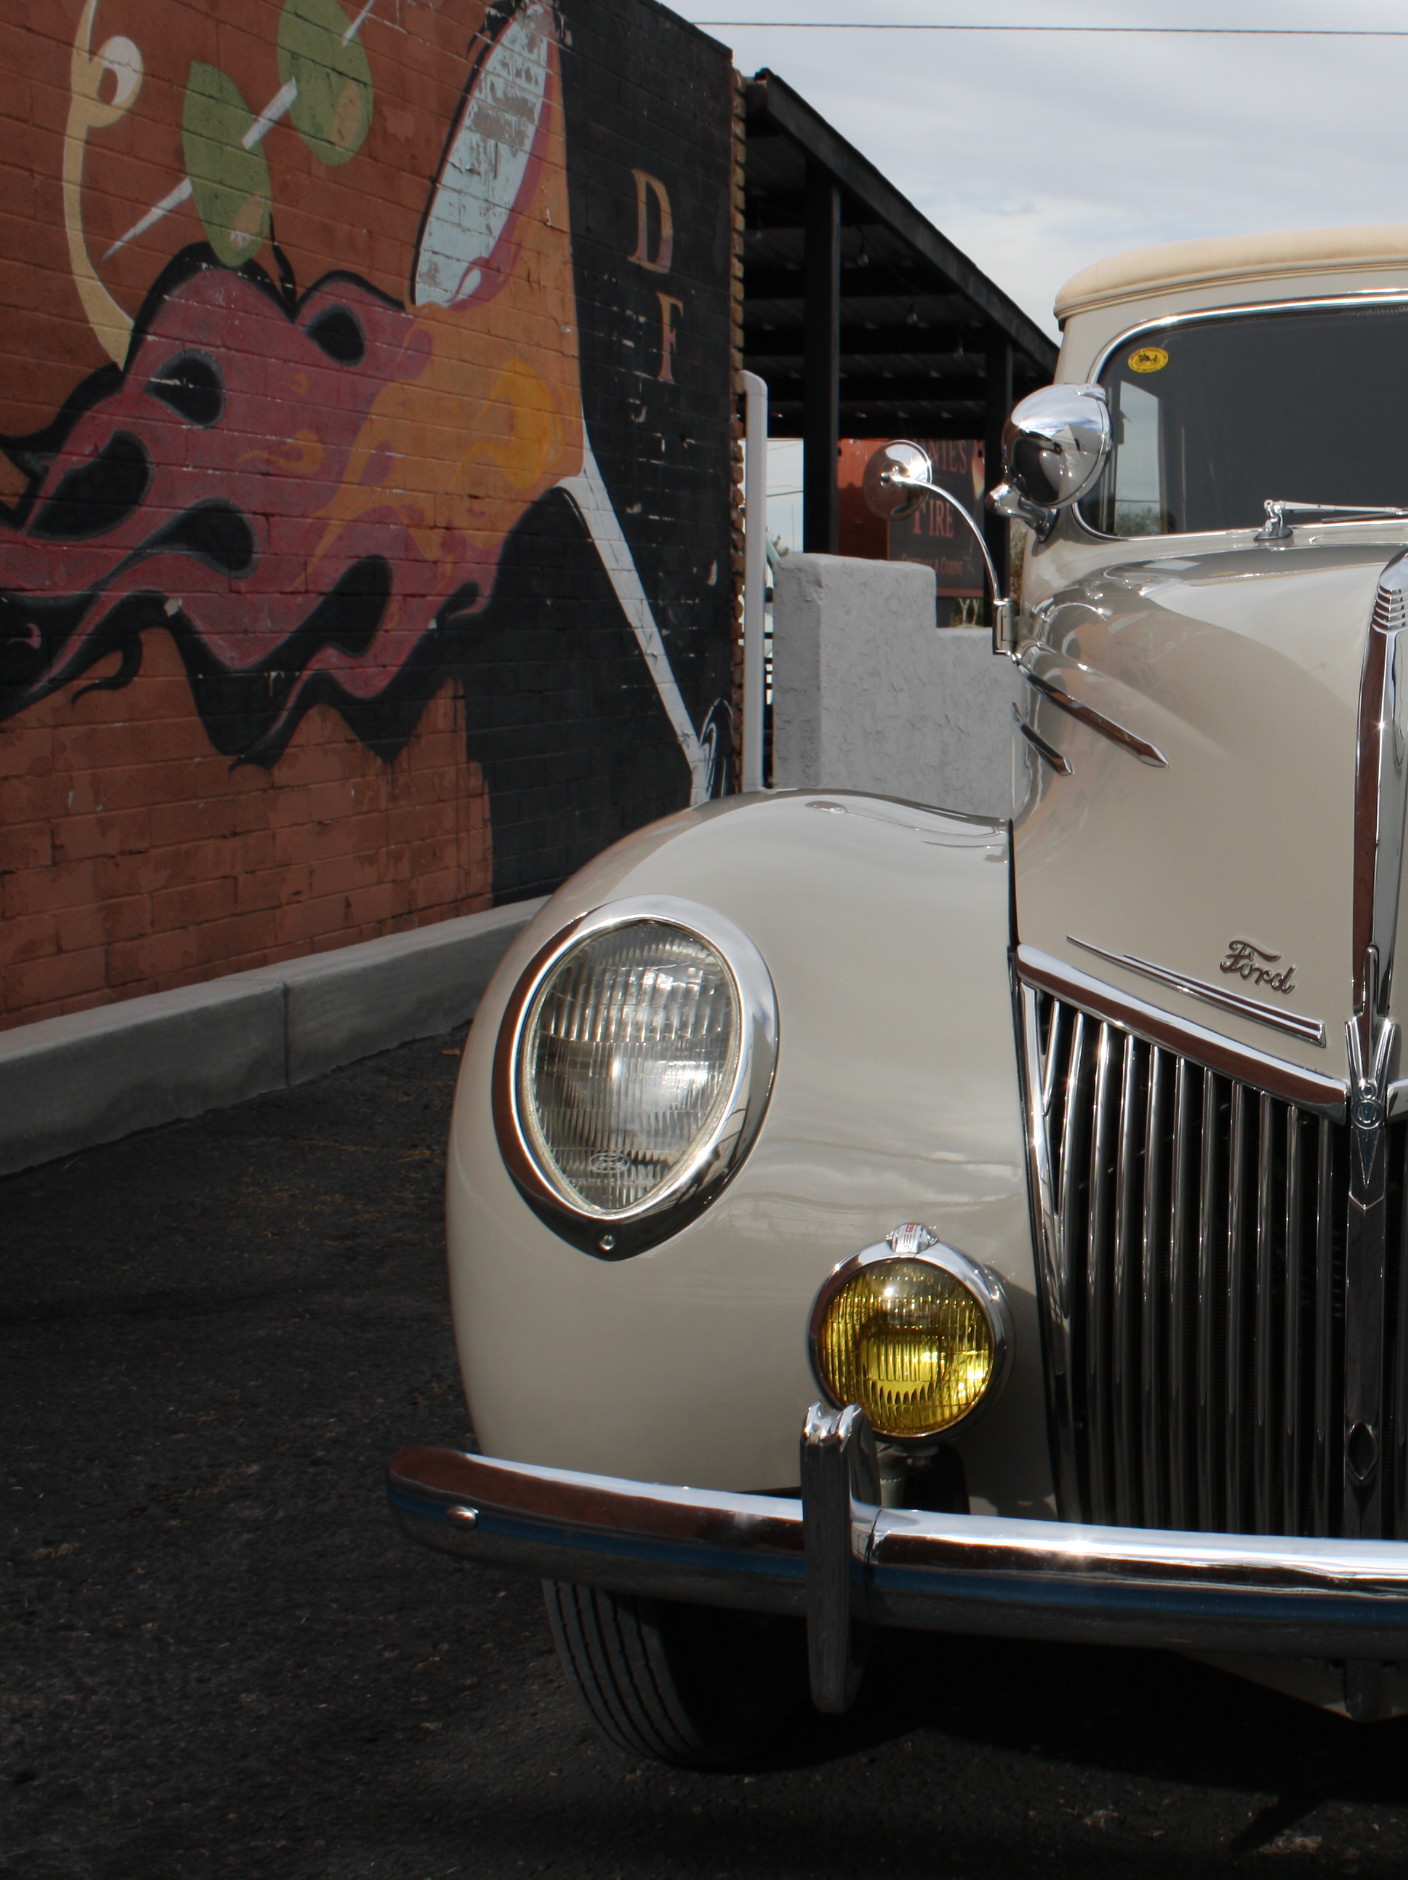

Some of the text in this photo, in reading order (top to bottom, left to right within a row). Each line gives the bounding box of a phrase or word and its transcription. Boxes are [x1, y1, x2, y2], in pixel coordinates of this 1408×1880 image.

[627, 167, 674, 274] D
[656, 291, 684, 385] F
[1219, 938, 1297, 995] Ford
